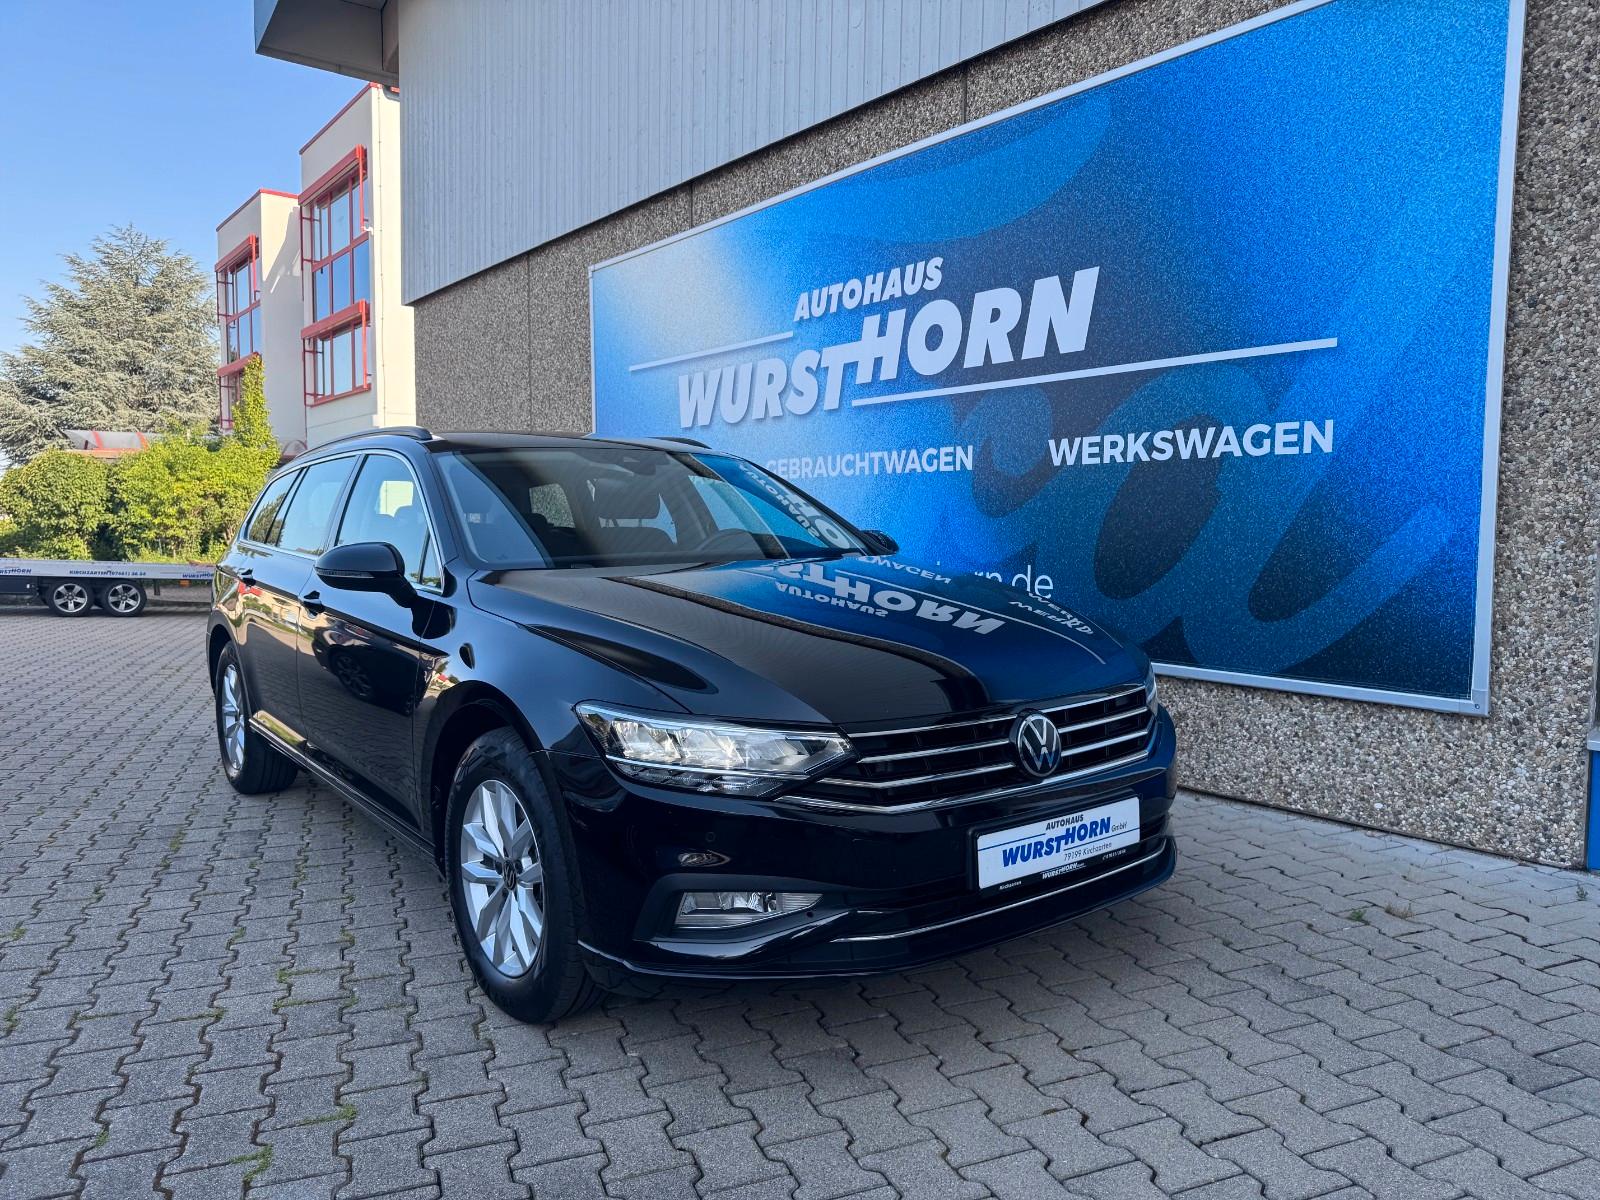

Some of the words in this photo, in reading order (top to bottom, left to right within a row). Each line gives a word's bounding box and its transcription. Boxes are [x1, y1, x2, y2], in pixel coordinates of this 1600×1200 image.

[794, 257, 944, 322] AUTOHAUS
[678, 266, 1100, 429] WURSTHORN
[1048, 419, 1335, 467] WERKSWAGEN
[1002, 817, 1111, 867] WURSTHORN
[1046, 814, 1084, 830] AUTOHAUS
